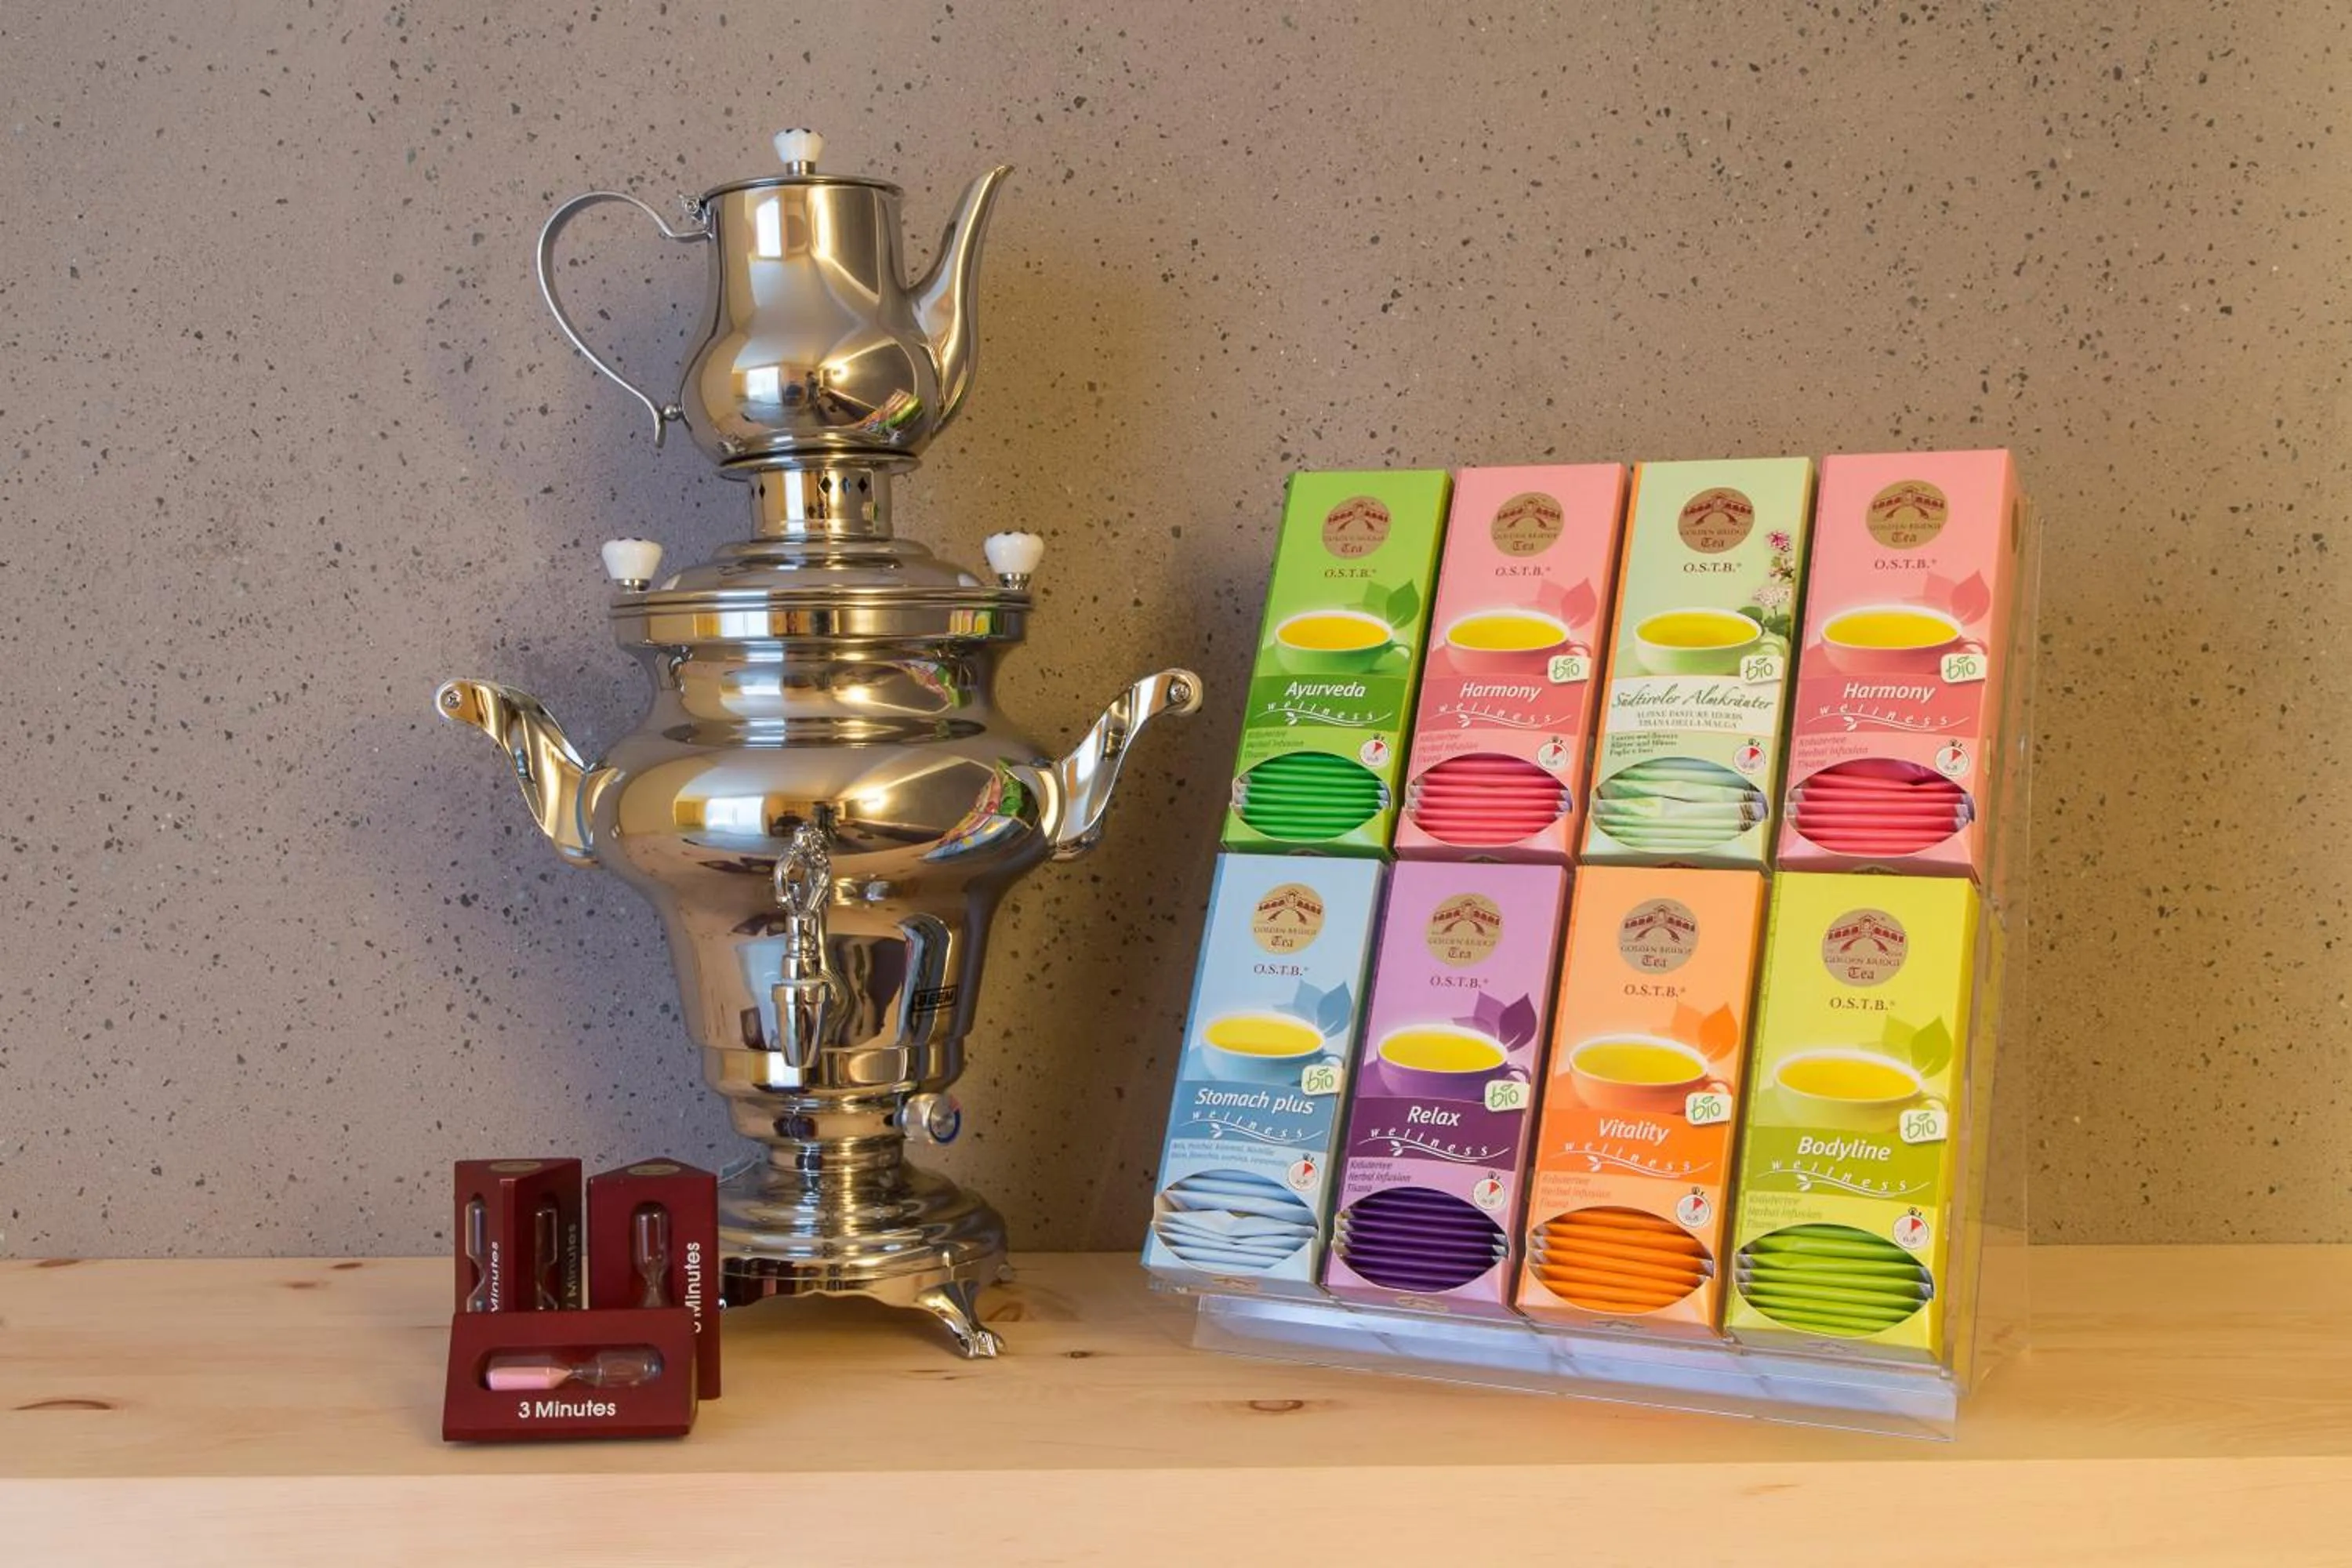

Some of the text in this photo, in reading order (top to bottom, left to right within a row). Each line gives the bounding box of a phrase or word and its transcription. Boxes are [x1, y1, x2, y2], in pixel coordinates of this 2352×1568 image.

[1552, 658, 1580, 680] bio
[1745, 658, 1773, 681] bio
[1946, 655, 1976, 680] bio
[1285, 681, 1367, 700] Ayurveda
[1460, 681, 1542, 702] Harmony
[1843, 682, 1936, 703] Harmony
[1267, 701, 1374, 720] wellness
[1439, 702, 1552, 723] wellness
[1820, 703, 1947, 726] wellness
[1306, 1068, 1334, 1092] bio
[1195, 1087, 1315, 1115] Stomach plus
[1490, 1083, 1519, 1108] bio
[1691, 1095, 1722, 1121] bio
[1192, 1111, 1303, 1138] wellness
[1407, 1105, 1461, 1127] Relax
[1905, 1112, 1937, 1138] bio
[1370, 1126, 1488, 1156] wellness
[1599, 1117, 1671, 1146] Vitality
[1565, 1142, 1691, 1171] wellness
[1797, 1135, 1892, 1162] Bodyline
[1771, 1160, 1907, 1191] wellness
[684, 1241, 702, 1317] Minutes
[518, 1400, 617, 1418] 3 Minutes
